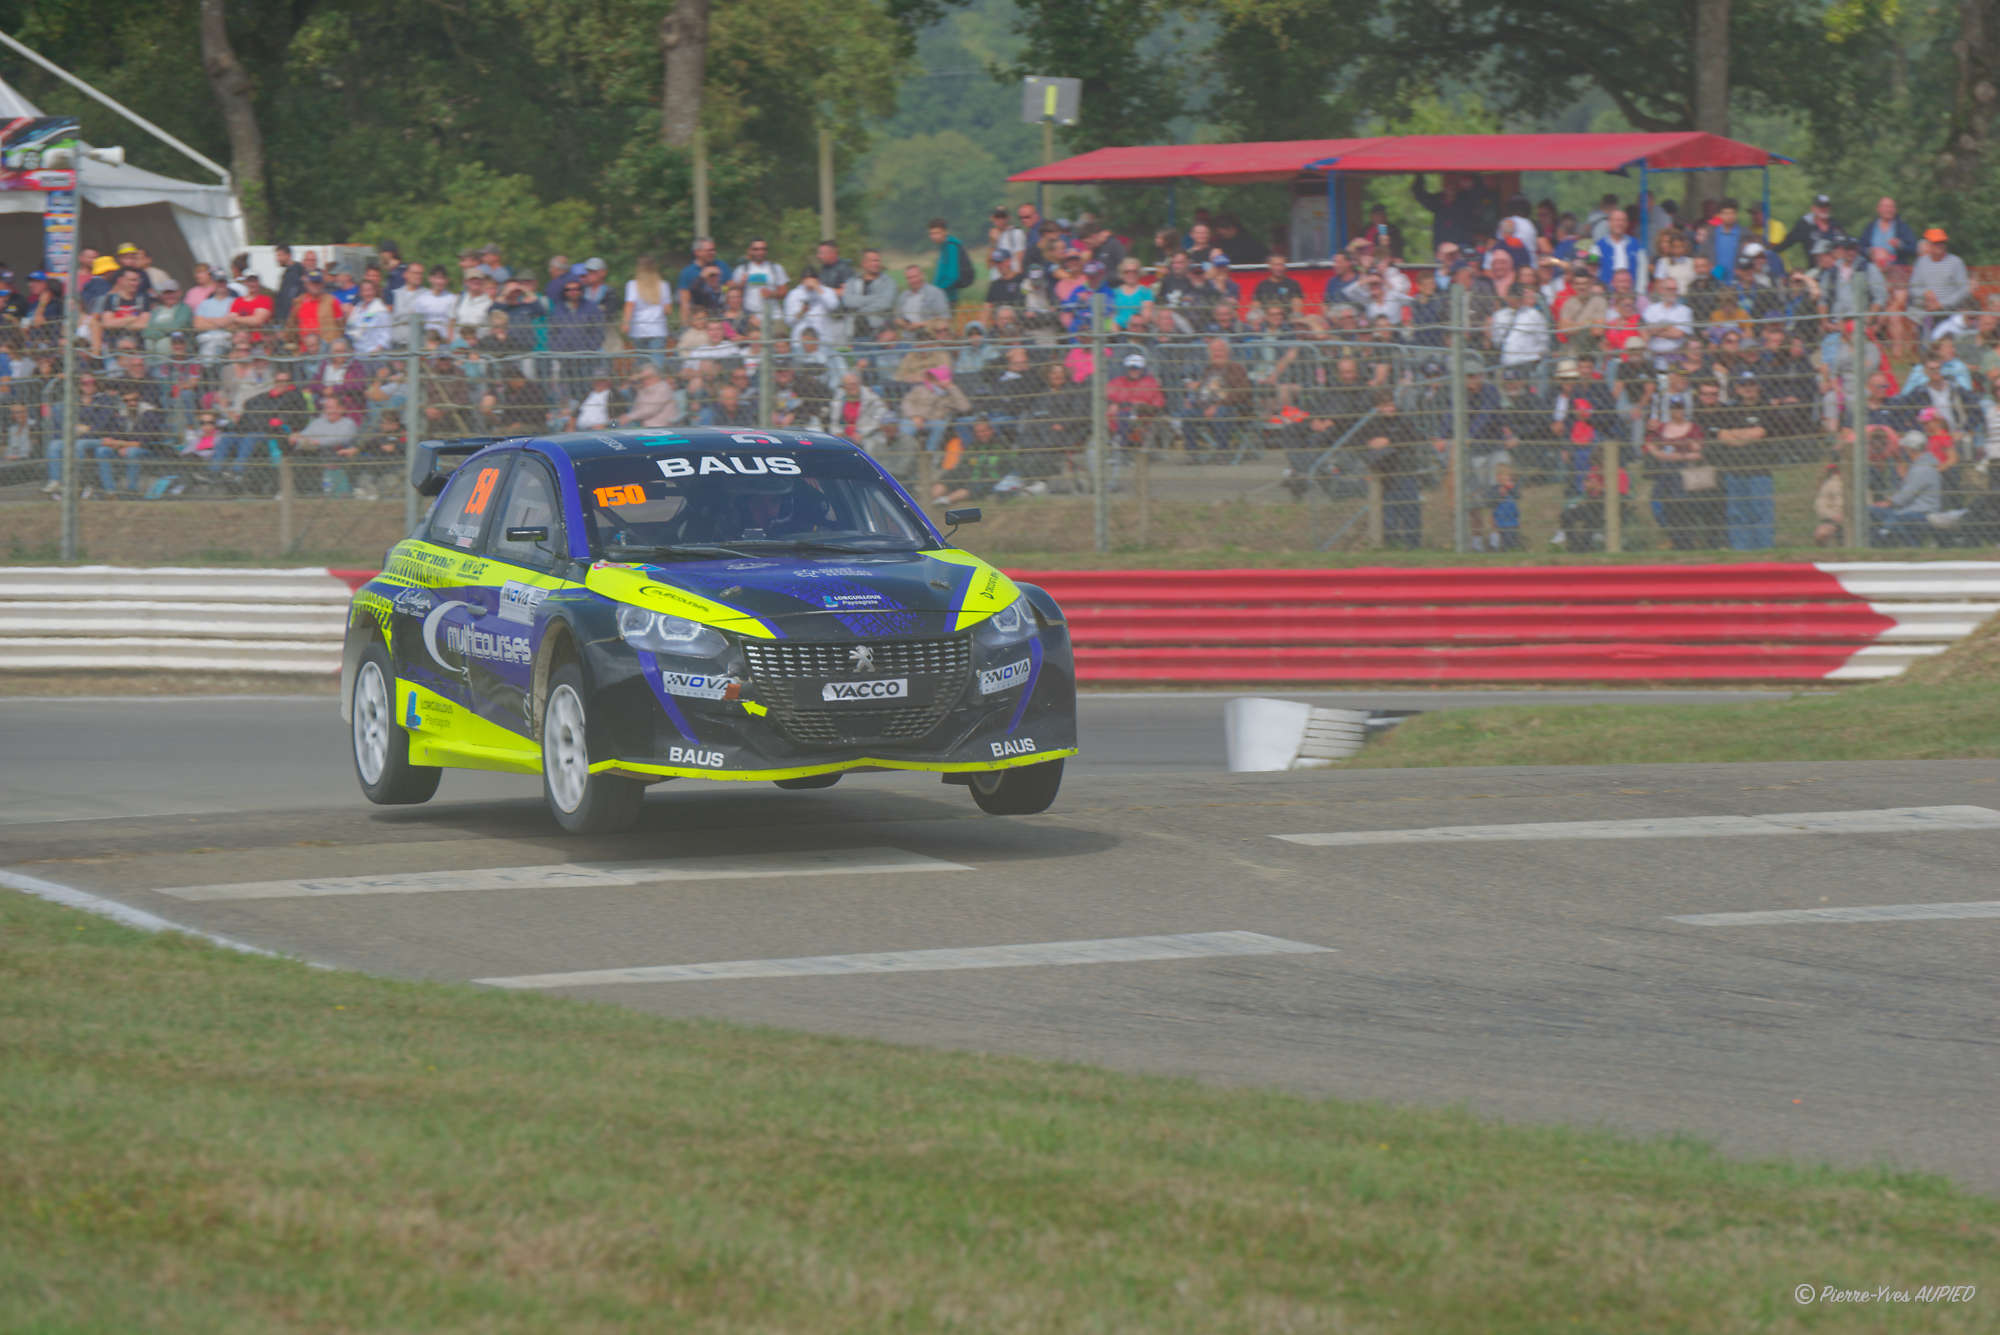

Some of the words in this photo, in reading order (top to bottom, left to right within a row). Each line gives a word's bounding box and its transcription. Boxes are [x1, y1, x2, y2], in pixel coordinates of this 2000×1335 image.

[656, 456, 802, 478] BAUS
[464, 468, 500, 515] 150
[593, 484, 647, 508] 150
[990, 660, 1030, 684] NOVA
[831, 682, 900, 699] YACCO
[669, 746, 725, 768] BAUS
[990, 737, 1037, 758] BAUS
